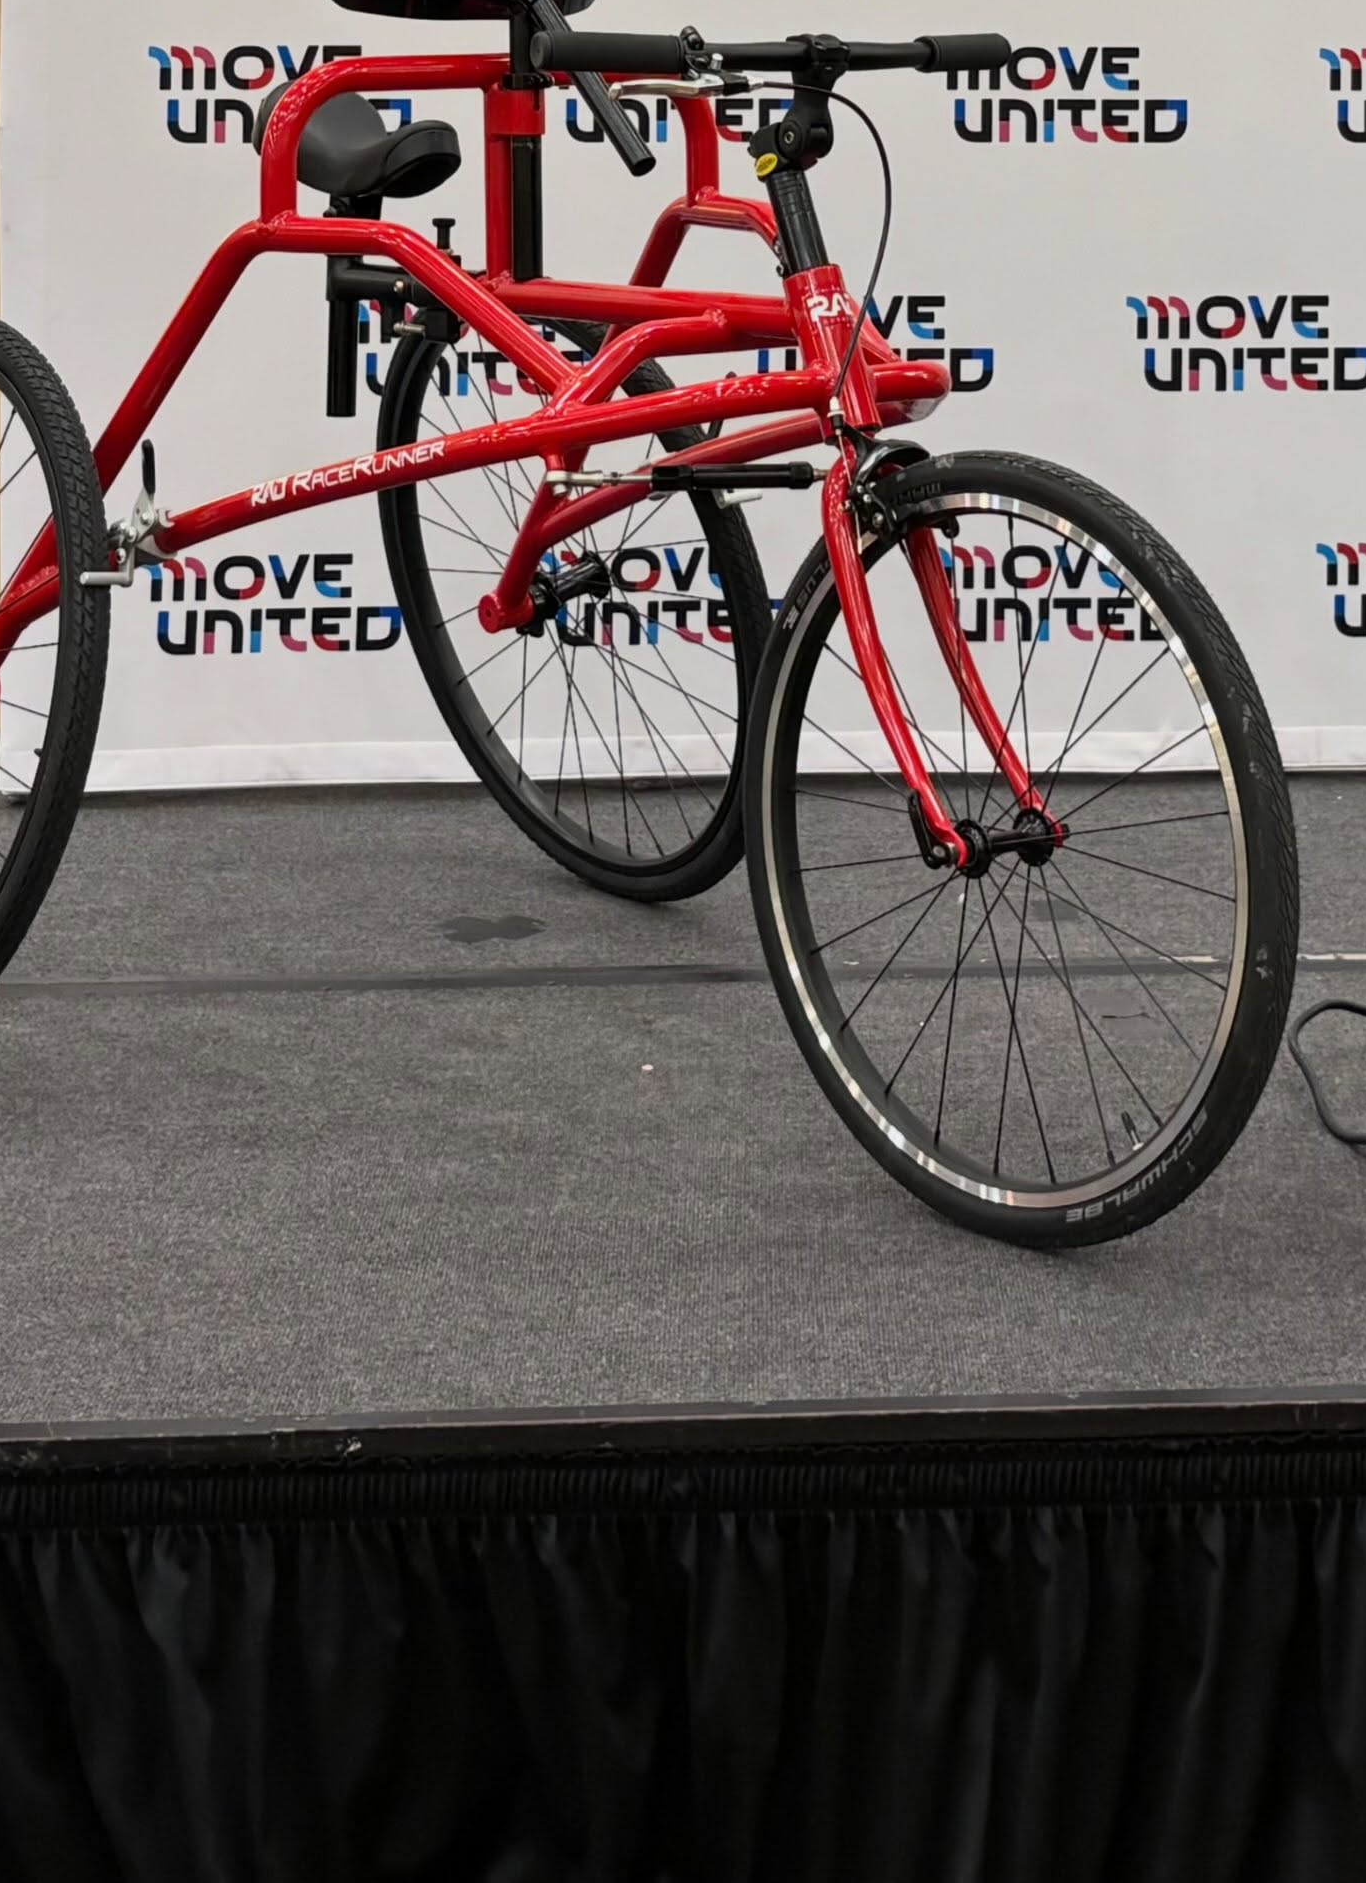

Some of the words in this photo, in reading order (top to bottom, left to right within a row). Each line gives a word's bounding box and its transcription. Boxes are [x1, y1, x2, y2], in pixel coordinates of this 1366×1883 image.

[954, 99, 1188, 143] UNITED
[1126, 295, 1330, 339] MOVE
[157, 606, 403, 655] UNITED
